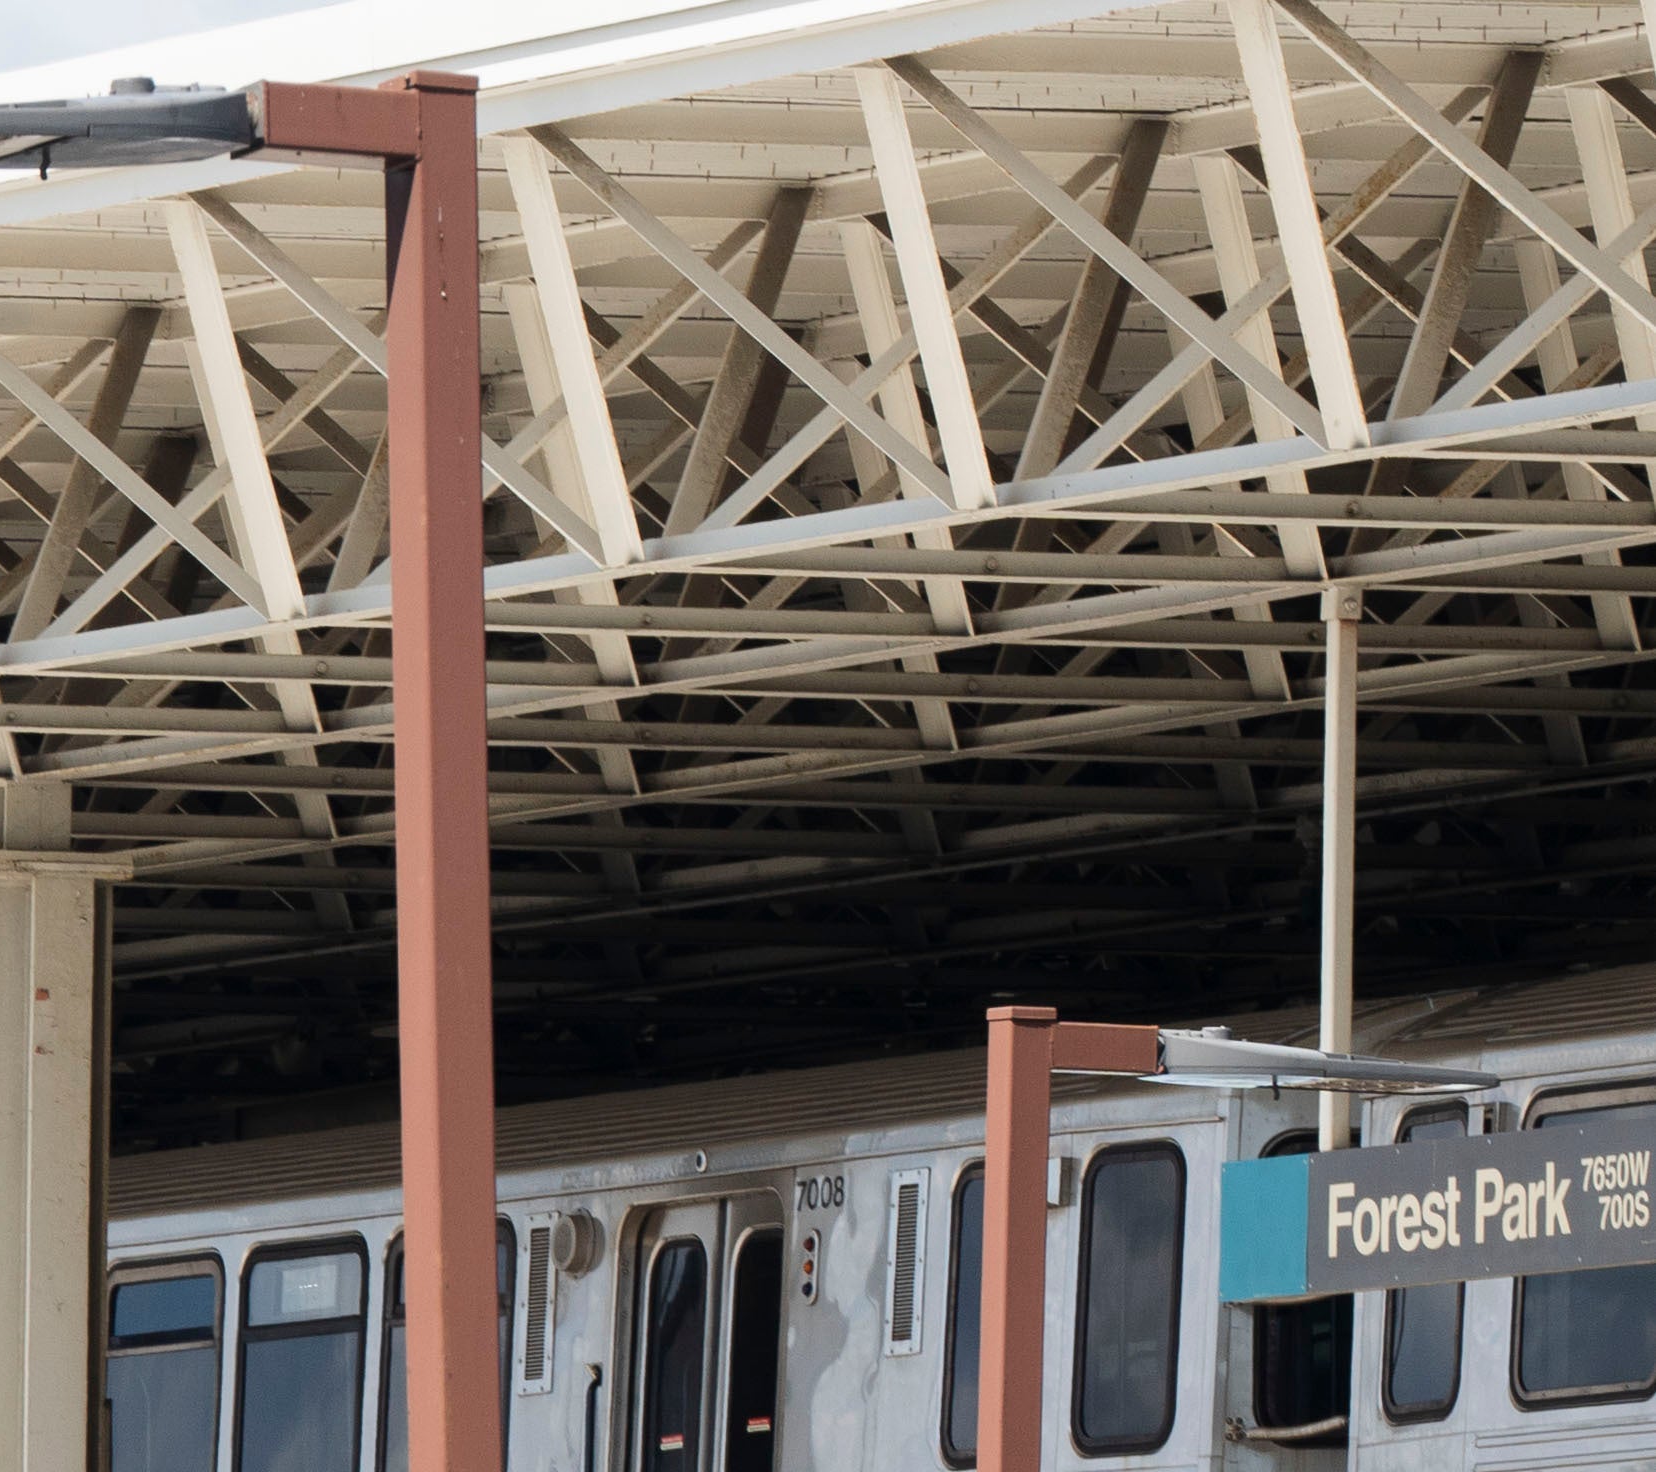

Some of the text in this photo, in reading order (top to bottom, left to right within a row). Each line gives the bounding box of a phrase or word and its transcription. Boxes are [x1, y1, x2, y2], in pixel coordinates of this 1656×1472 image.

[795, 1174, 846, 1212] 7008
[1328, 1150, 1651, 1259] Forest Park 7650W
[1597, 1190, 1650, 1231] 700S
